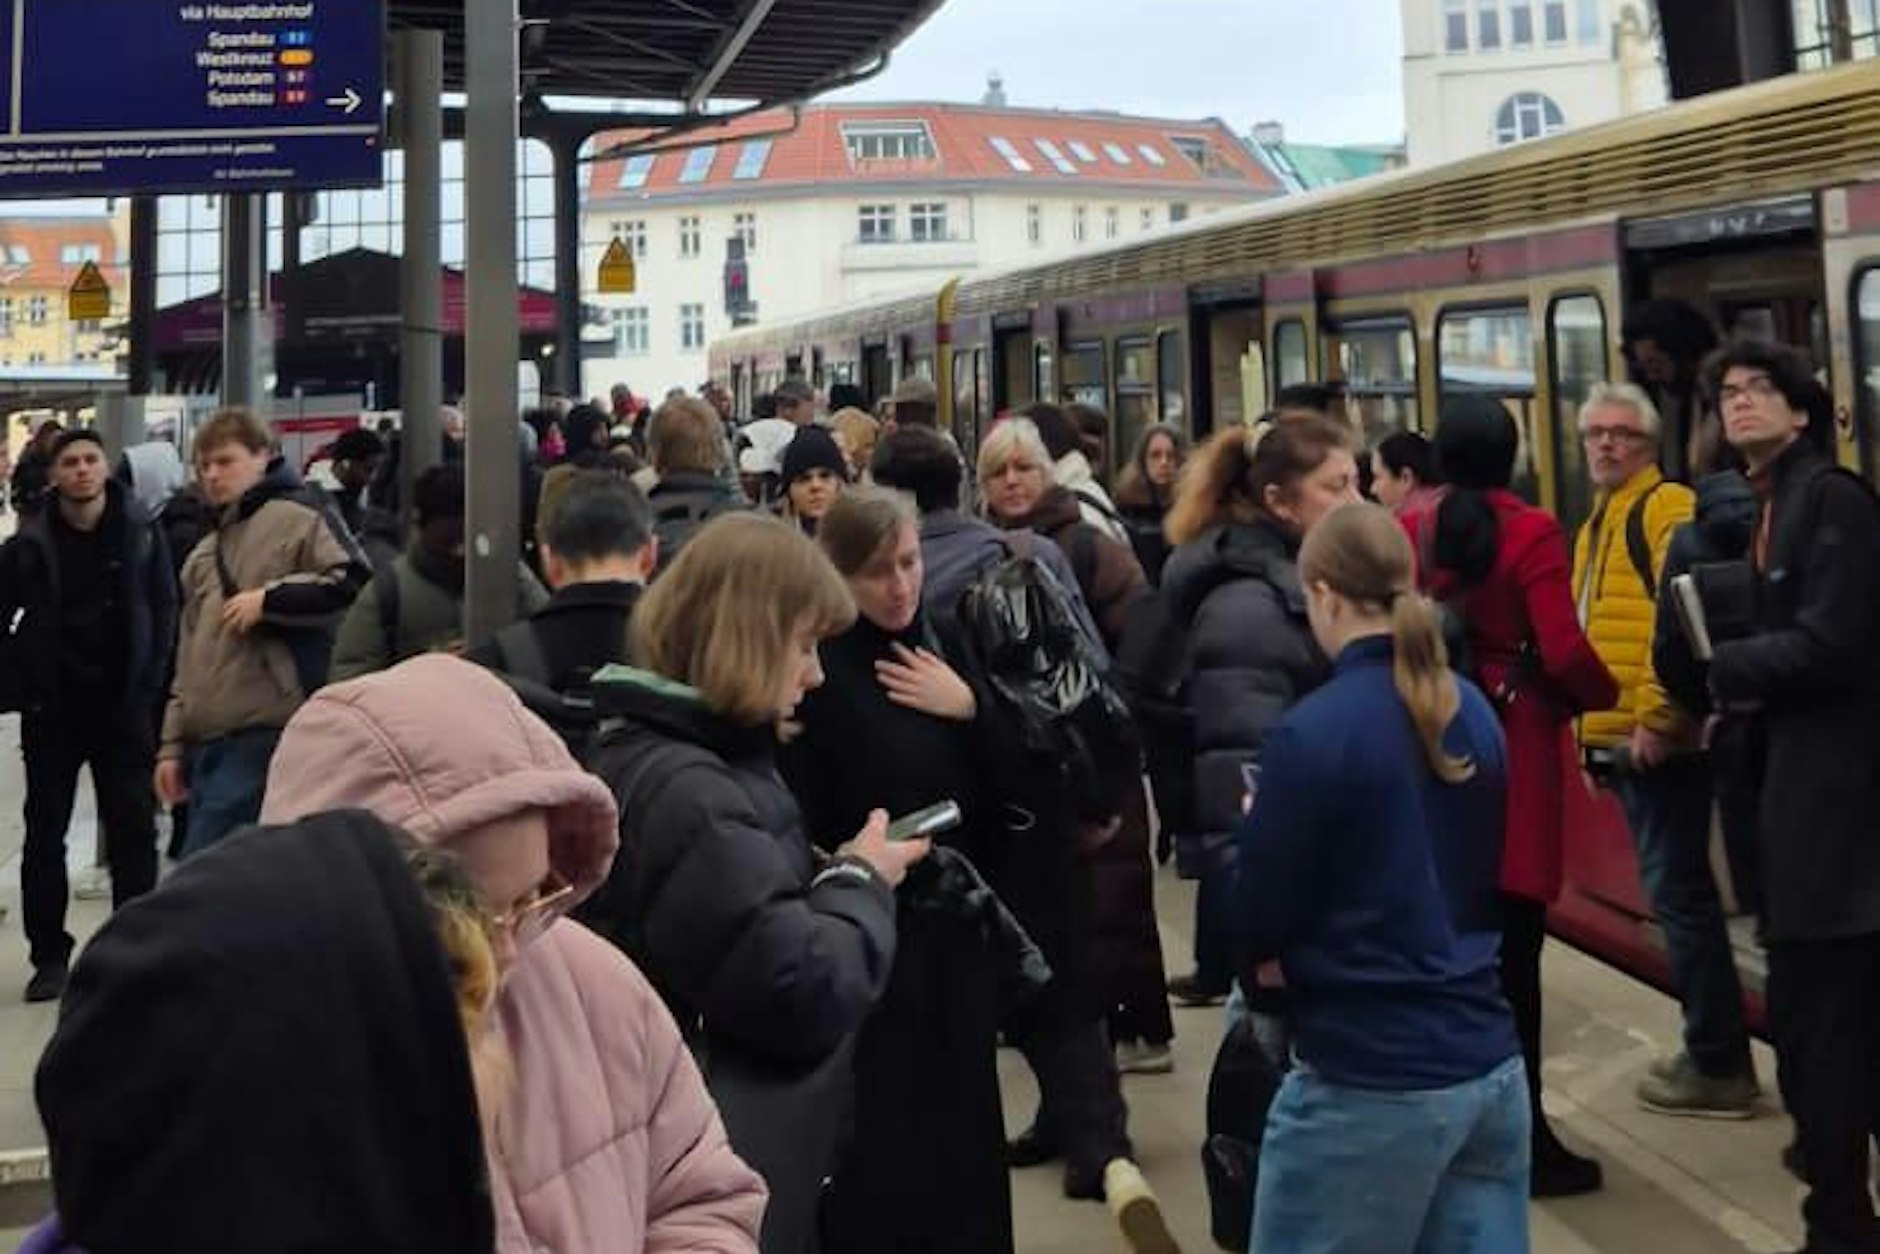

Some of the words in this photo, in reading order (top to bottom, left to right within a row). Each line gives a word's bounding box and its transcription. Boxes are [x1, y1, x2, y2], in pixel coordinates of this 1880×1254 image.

[206, 2, 314, 22] Hauptbahnhof
[208, 32, 275, 49] Spandau
[196, 51, 274, 67] Westkreuz
[208, 70, 275, 86] Potsdam
[207, 90, 275, 107] Spandau
